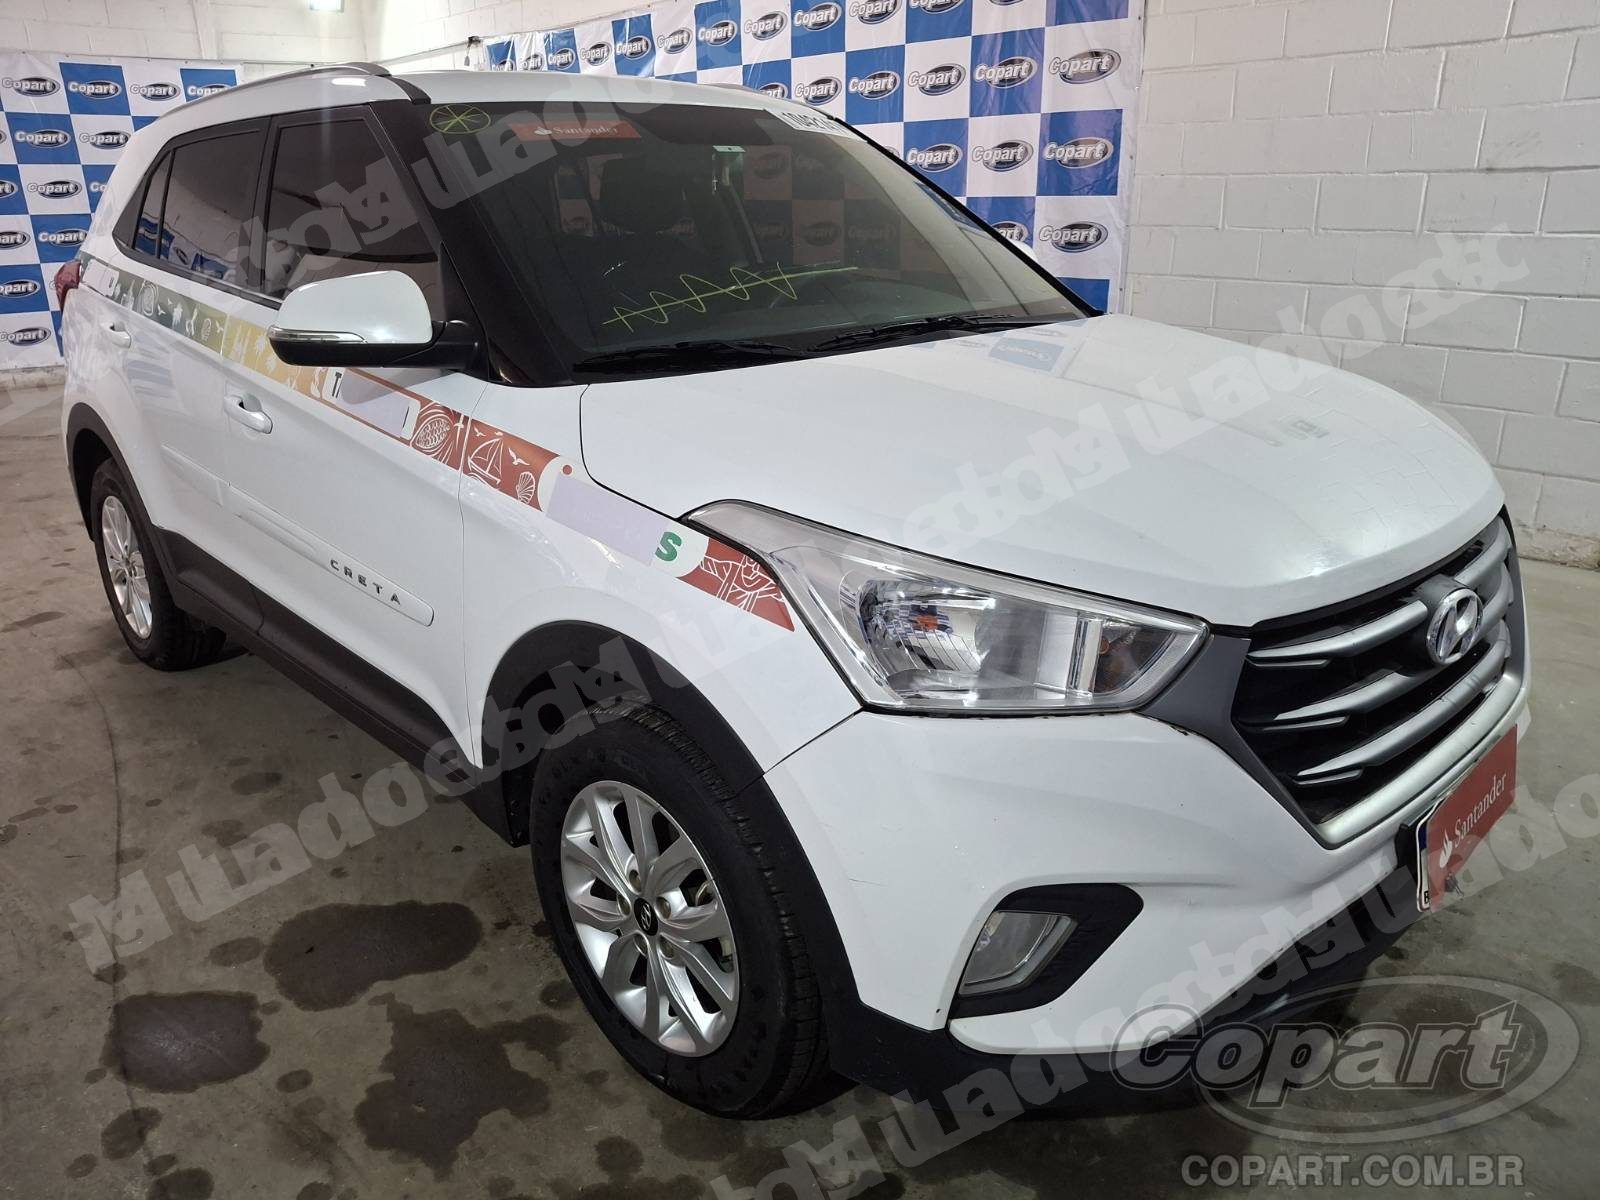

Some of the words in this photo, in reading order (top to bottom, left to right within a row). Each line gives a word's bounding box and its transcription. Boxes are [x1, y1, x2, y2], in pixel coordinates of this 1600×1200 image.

[794, 10, 836, 27] Copart
[849, 0, 895, 21] Copart
[698, 22, 735, 41] Copart
[745, 15, 782, 33] Copart
[616, 40, 648, 55] Copart
[657, 33, 690, 49] Copart
[548, 51, 572, 66] Copart
[580, 47, 609, 60] Copart
[975, 61, 1030, 83] Copart
[1049, 52, 1111, 75] Copart
[2, 77, 52, 94] Copart
[68, 80, 115, 95] Copart
[849, 74, 896, 96] Copart
[908, 68, 959, 90] Copart
[130, 83, 176, 97] Copart
[794, 82, 837, 99] Copart
[15, 130, 64, 145] Copart
[79, 132, 125, 145] Copart
[552, 126, 619, 135] Santander
[907, 146, 956, 167] Copart
[972, 144, 1025, 165] Copart
[1045, 141, 1104, 163] Copart
[27, 182, 75, 195] Copart
[38, 231, 85, 244] Copart
[1039, 225, 1098, 246] Copart
[0, 329, 45, 343] Copart
[330, 559, 401, 605] CRETA
[1454, 772, 1507, 849] Santander
